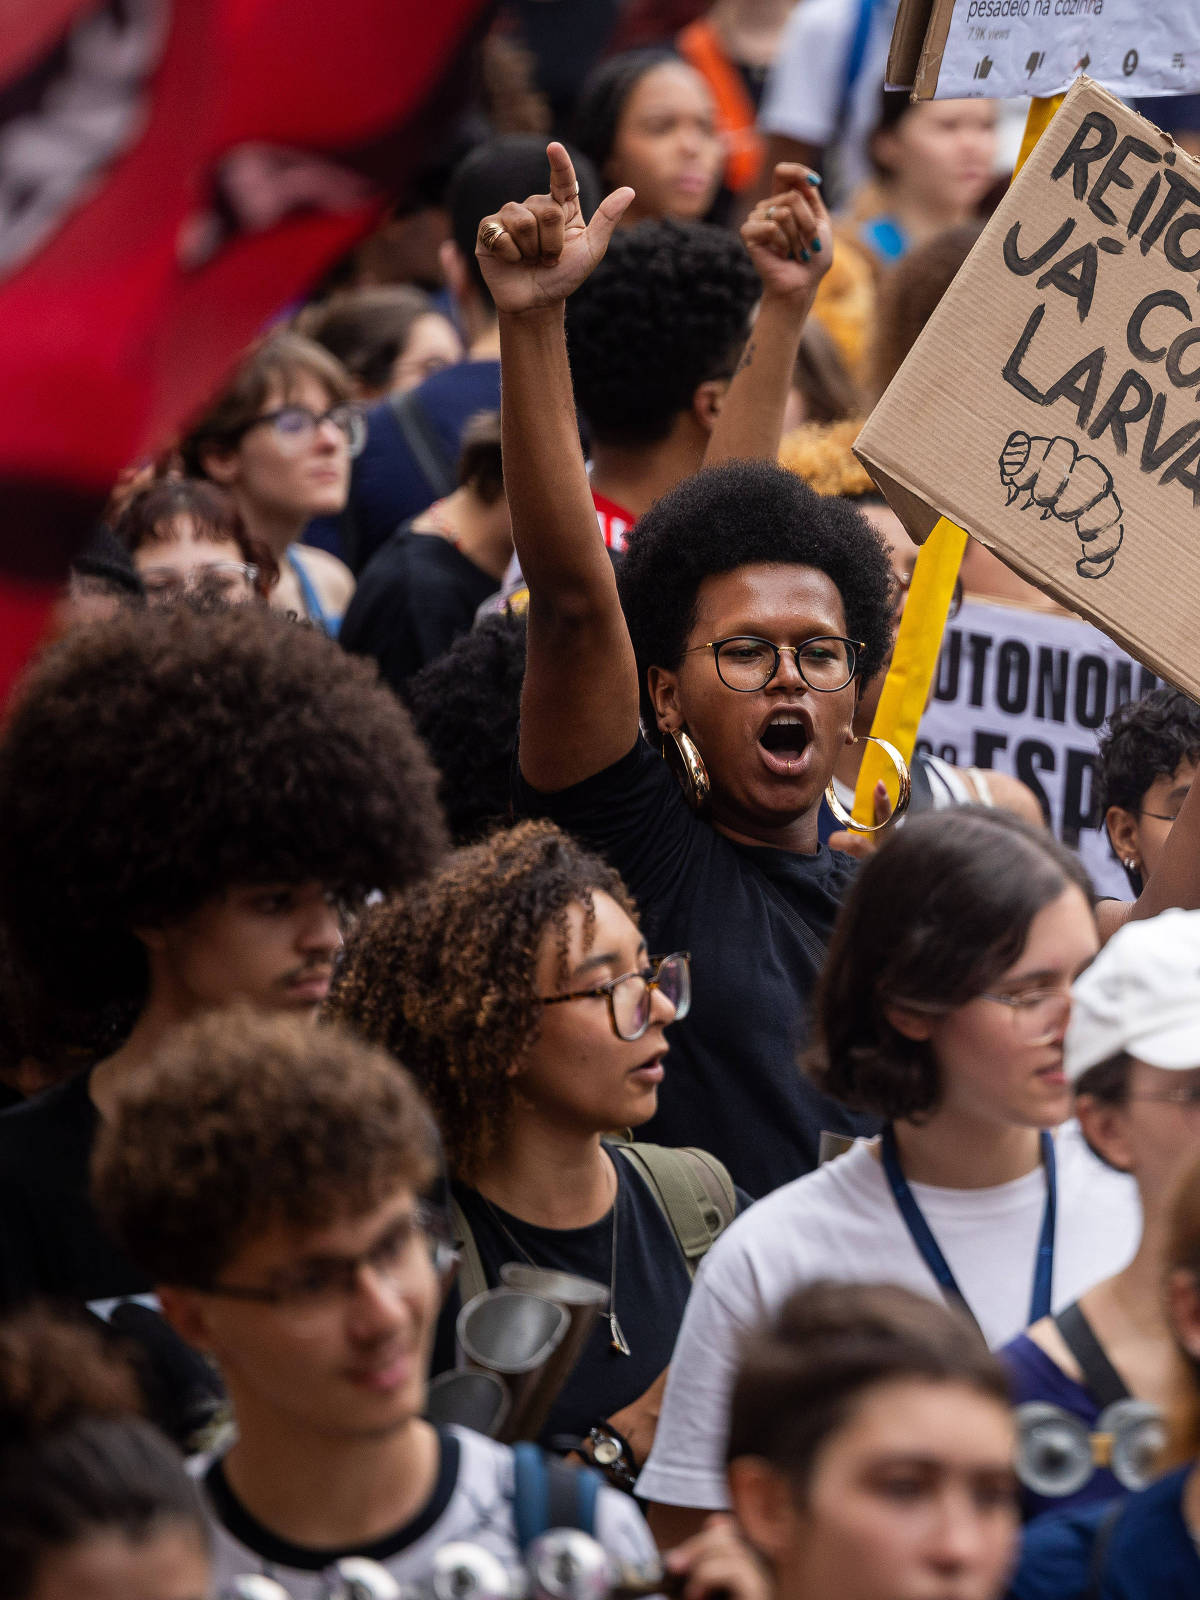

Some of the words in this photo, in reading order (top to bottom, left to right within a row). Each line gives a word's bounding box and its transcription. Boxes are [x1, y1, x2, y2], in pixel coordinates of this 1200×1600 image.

[966, 0, 1030, 22] pesadelo
[1033, 0, 1050, 16] na
[1054, 0, 1104, 16] cozinha
[1003, 217, 1126, 323] JÁ
[934, 629, 1157, 729] UTONO
